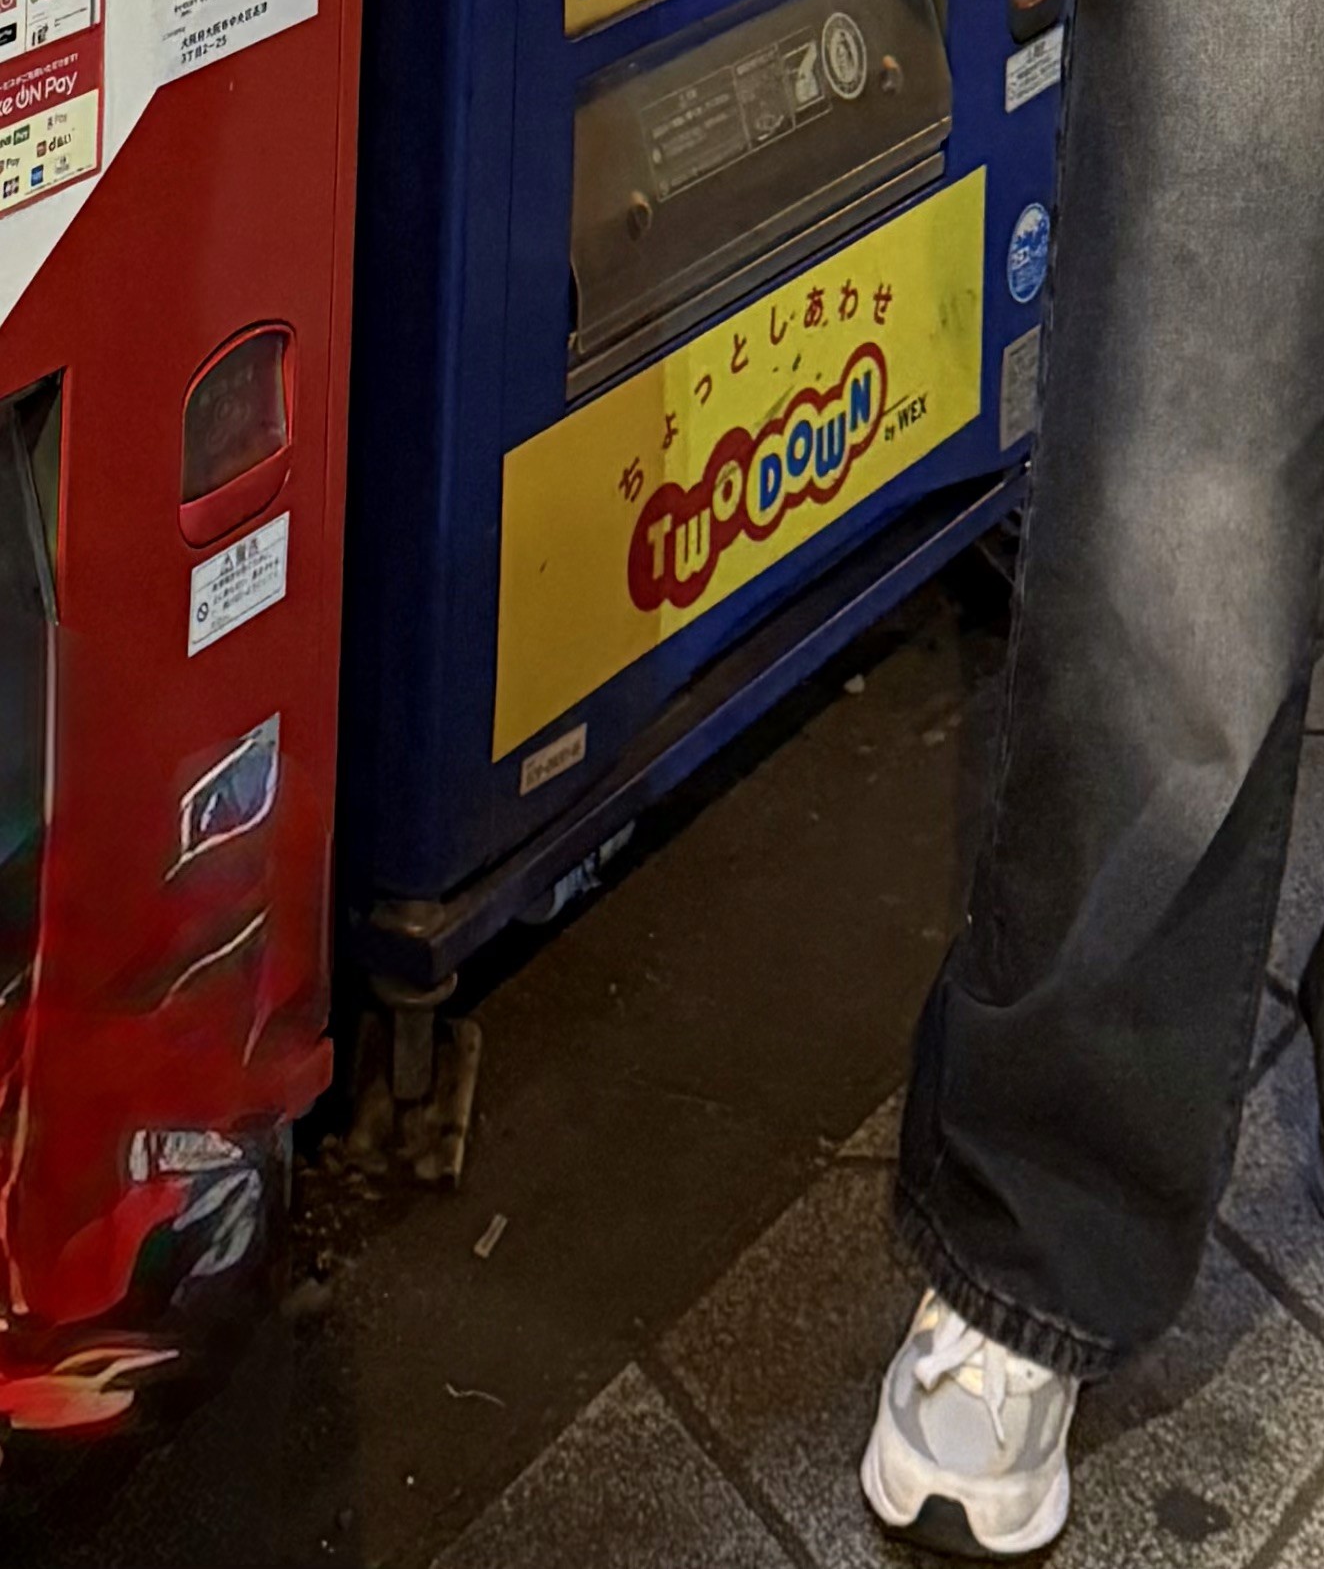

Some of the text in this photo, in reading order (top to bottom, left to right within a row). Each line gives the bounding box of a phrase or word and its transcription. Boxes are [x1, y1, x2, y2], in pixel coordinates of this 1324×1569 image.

[15, 70, 78, 109] ON Pay
[617, 277, 894, 504] ちょっとしあわせ
[897, 390, 929, 432] WEX
[646, 368, 873, 584] TWO DOWN
